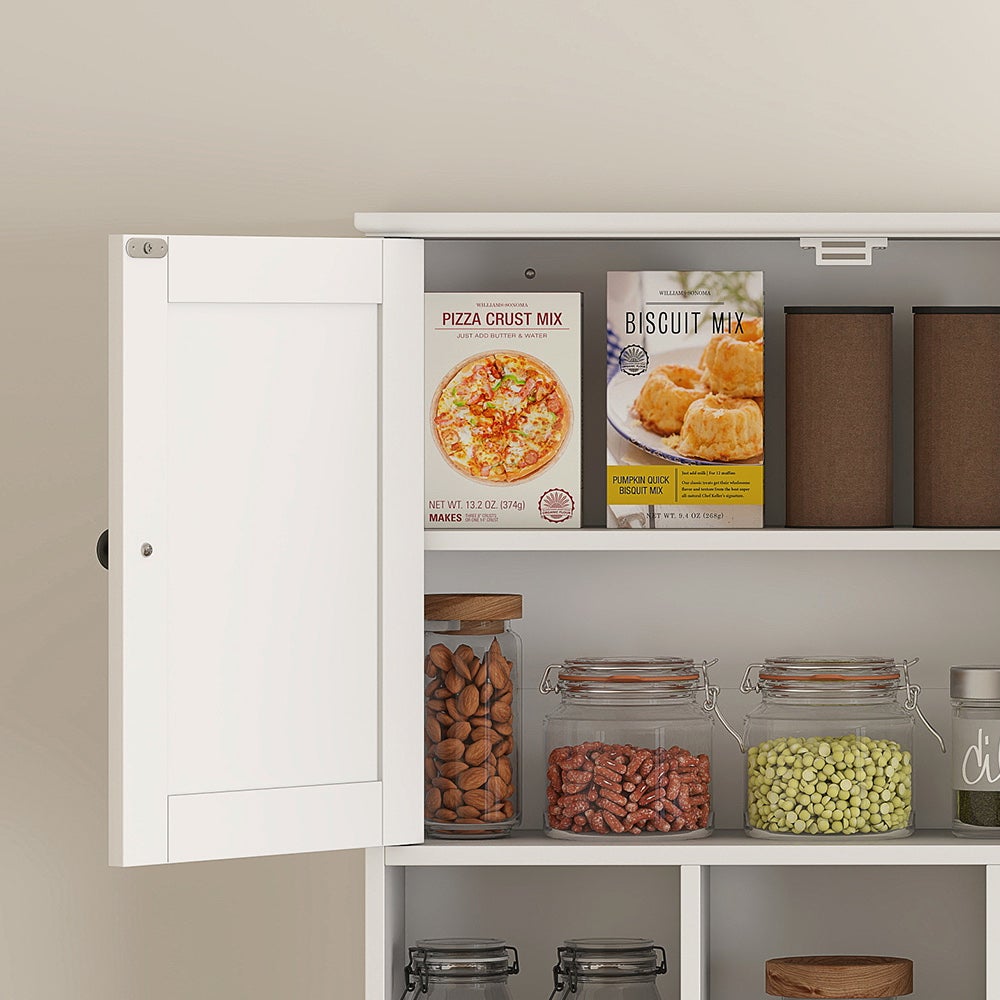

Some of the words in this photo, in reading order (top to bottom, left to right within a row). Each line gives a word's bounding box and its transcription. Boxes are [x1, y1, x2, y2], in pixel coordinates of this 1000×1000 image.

[442, 312, 482, 326] PIZZA
[485, 312, 532, 326] CRUST
[536, 312, 563, 326] MIX
[625, 311, 701, 335] BISCUIT
[712, 311, 745, 335] MIX
[612, 475, 646, 484] PUMPKIN
[647, 475, 670, 484] QUICK
[649, 486, 664, 495] MIX
[428, 500, 446, 509] NET
[447, 500, 463, 509] WT.
[466, 500, 483, 509] 13.2
[484, 500, 498, 509] OZ.
[500, 500, 526, 512] (374g)
[429, 513, 463, 522] MAKES
